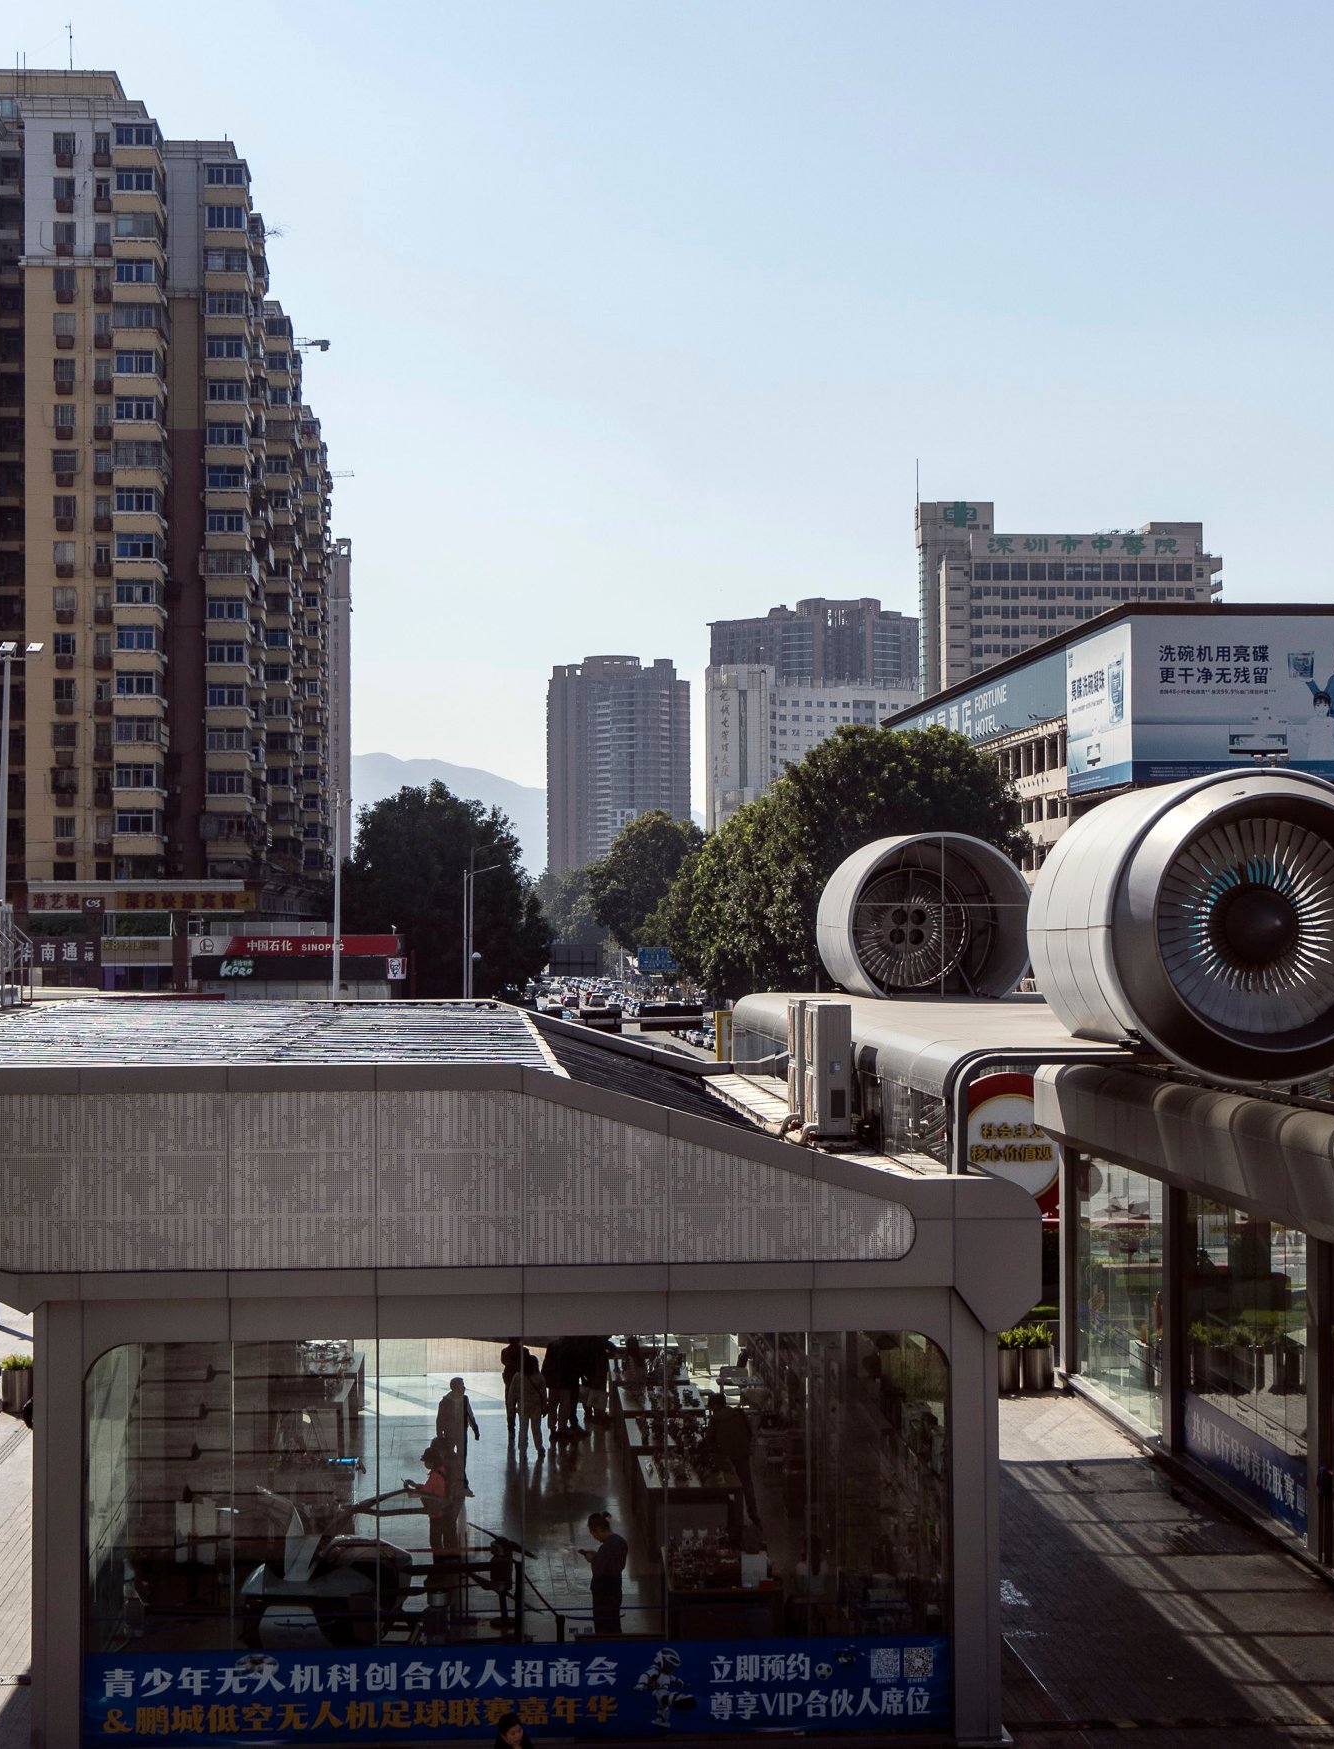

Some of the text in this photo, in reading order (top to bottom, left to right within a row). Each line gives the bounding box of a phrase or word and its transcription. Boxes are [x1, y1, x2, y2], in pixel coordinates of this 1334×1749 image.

[1159, 645, 1270, 663] 洗碗机用亮碟
[1159, 667, 1272, 685] 更干净无残留
[974, 684, 1007, 715] FORTUNE
[974, 713, 1001, 736] HOTEL
[247, 939, 293, 951] 中国石化
[981, 1123, 1044, 1140] 社会主义
[970, 1144, 1052, 1163] 核心价值观
[101, 1656, 620, 1698] 青少年无人机科创合伙人招商会
[709, 1652, 811, 1684] 立即预约
[709, 1687, 932, 1721] 尊享VIP合伙人席位
